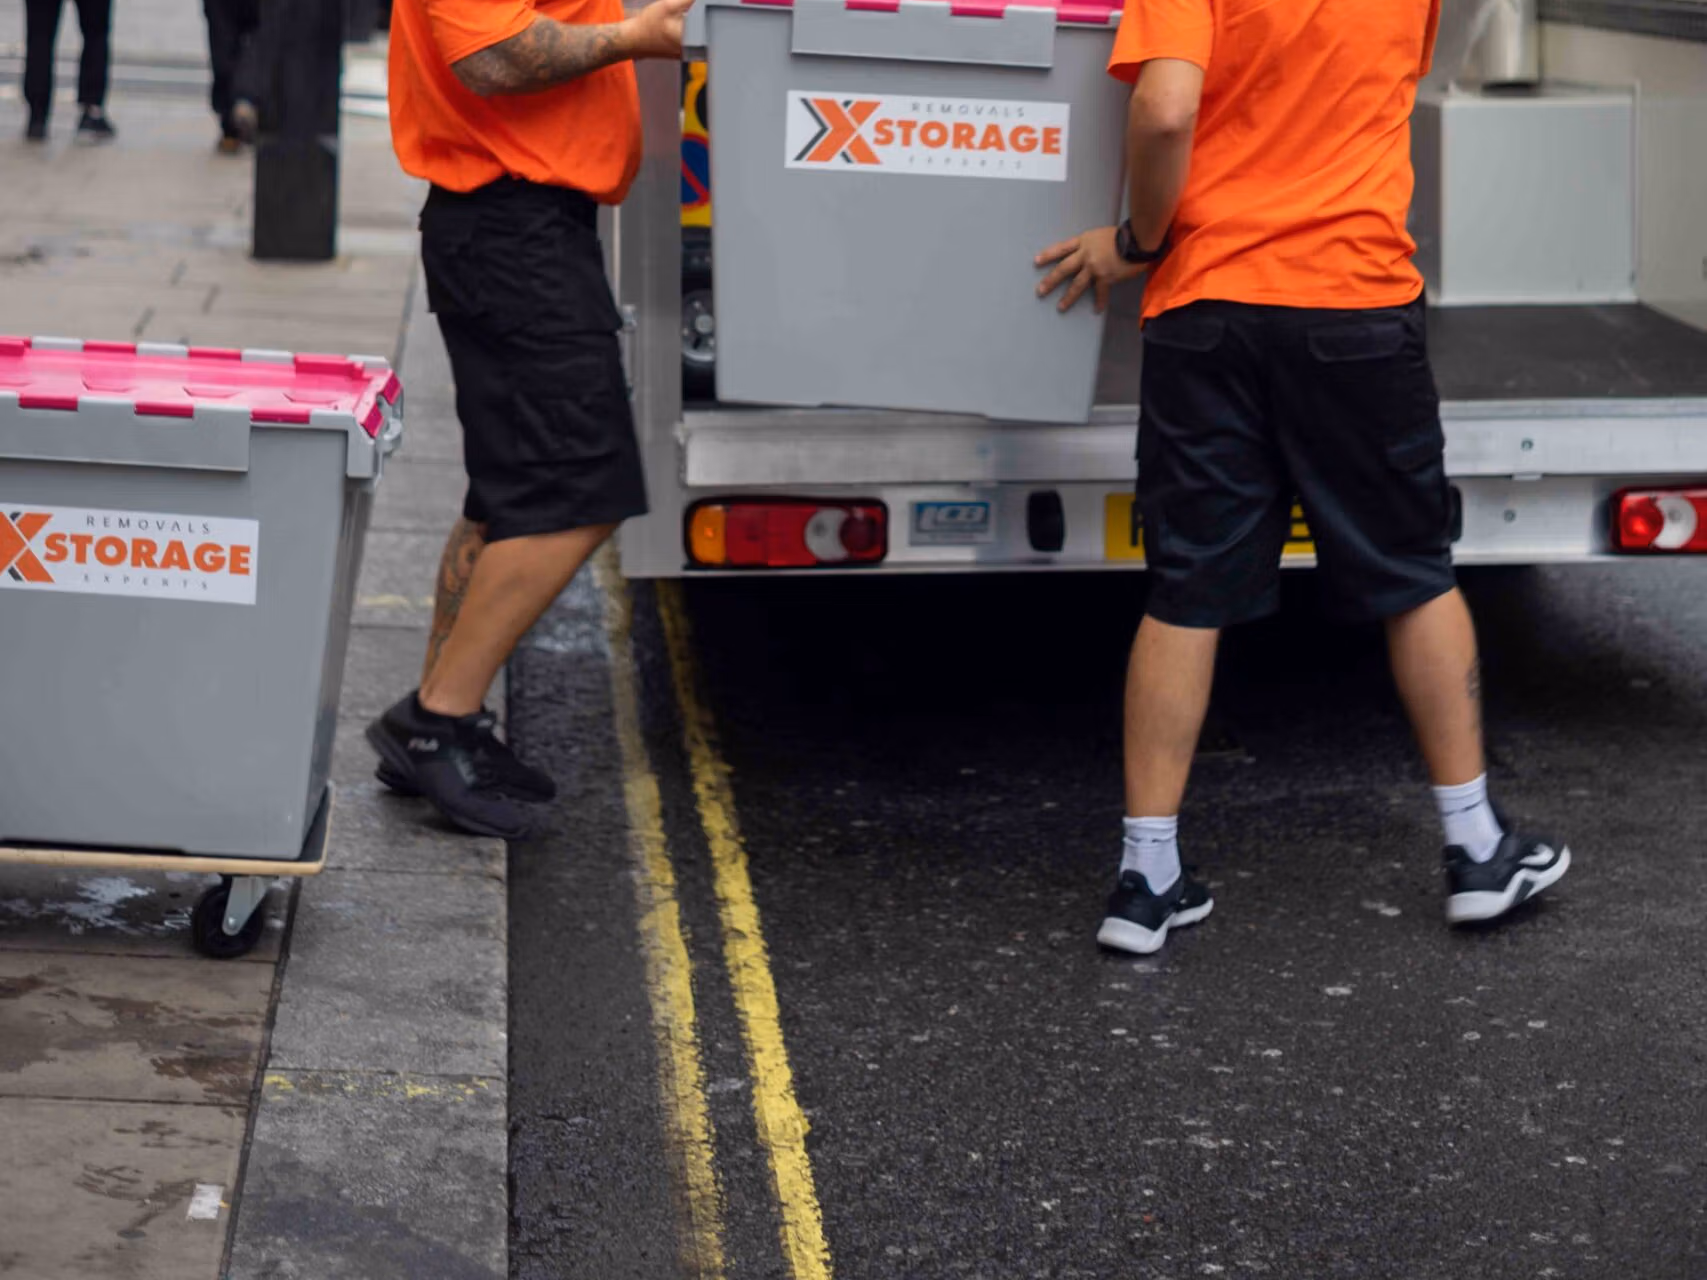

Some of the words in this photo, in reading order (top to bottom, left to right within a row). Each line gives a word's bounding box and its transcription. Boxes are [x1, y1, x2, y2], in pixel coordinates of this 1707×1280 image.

[872, 118, 1062, 155] STORAGE
[86, 514, 211, 534] REMOVALS
[43, 532, 251, 575] STORAGE
